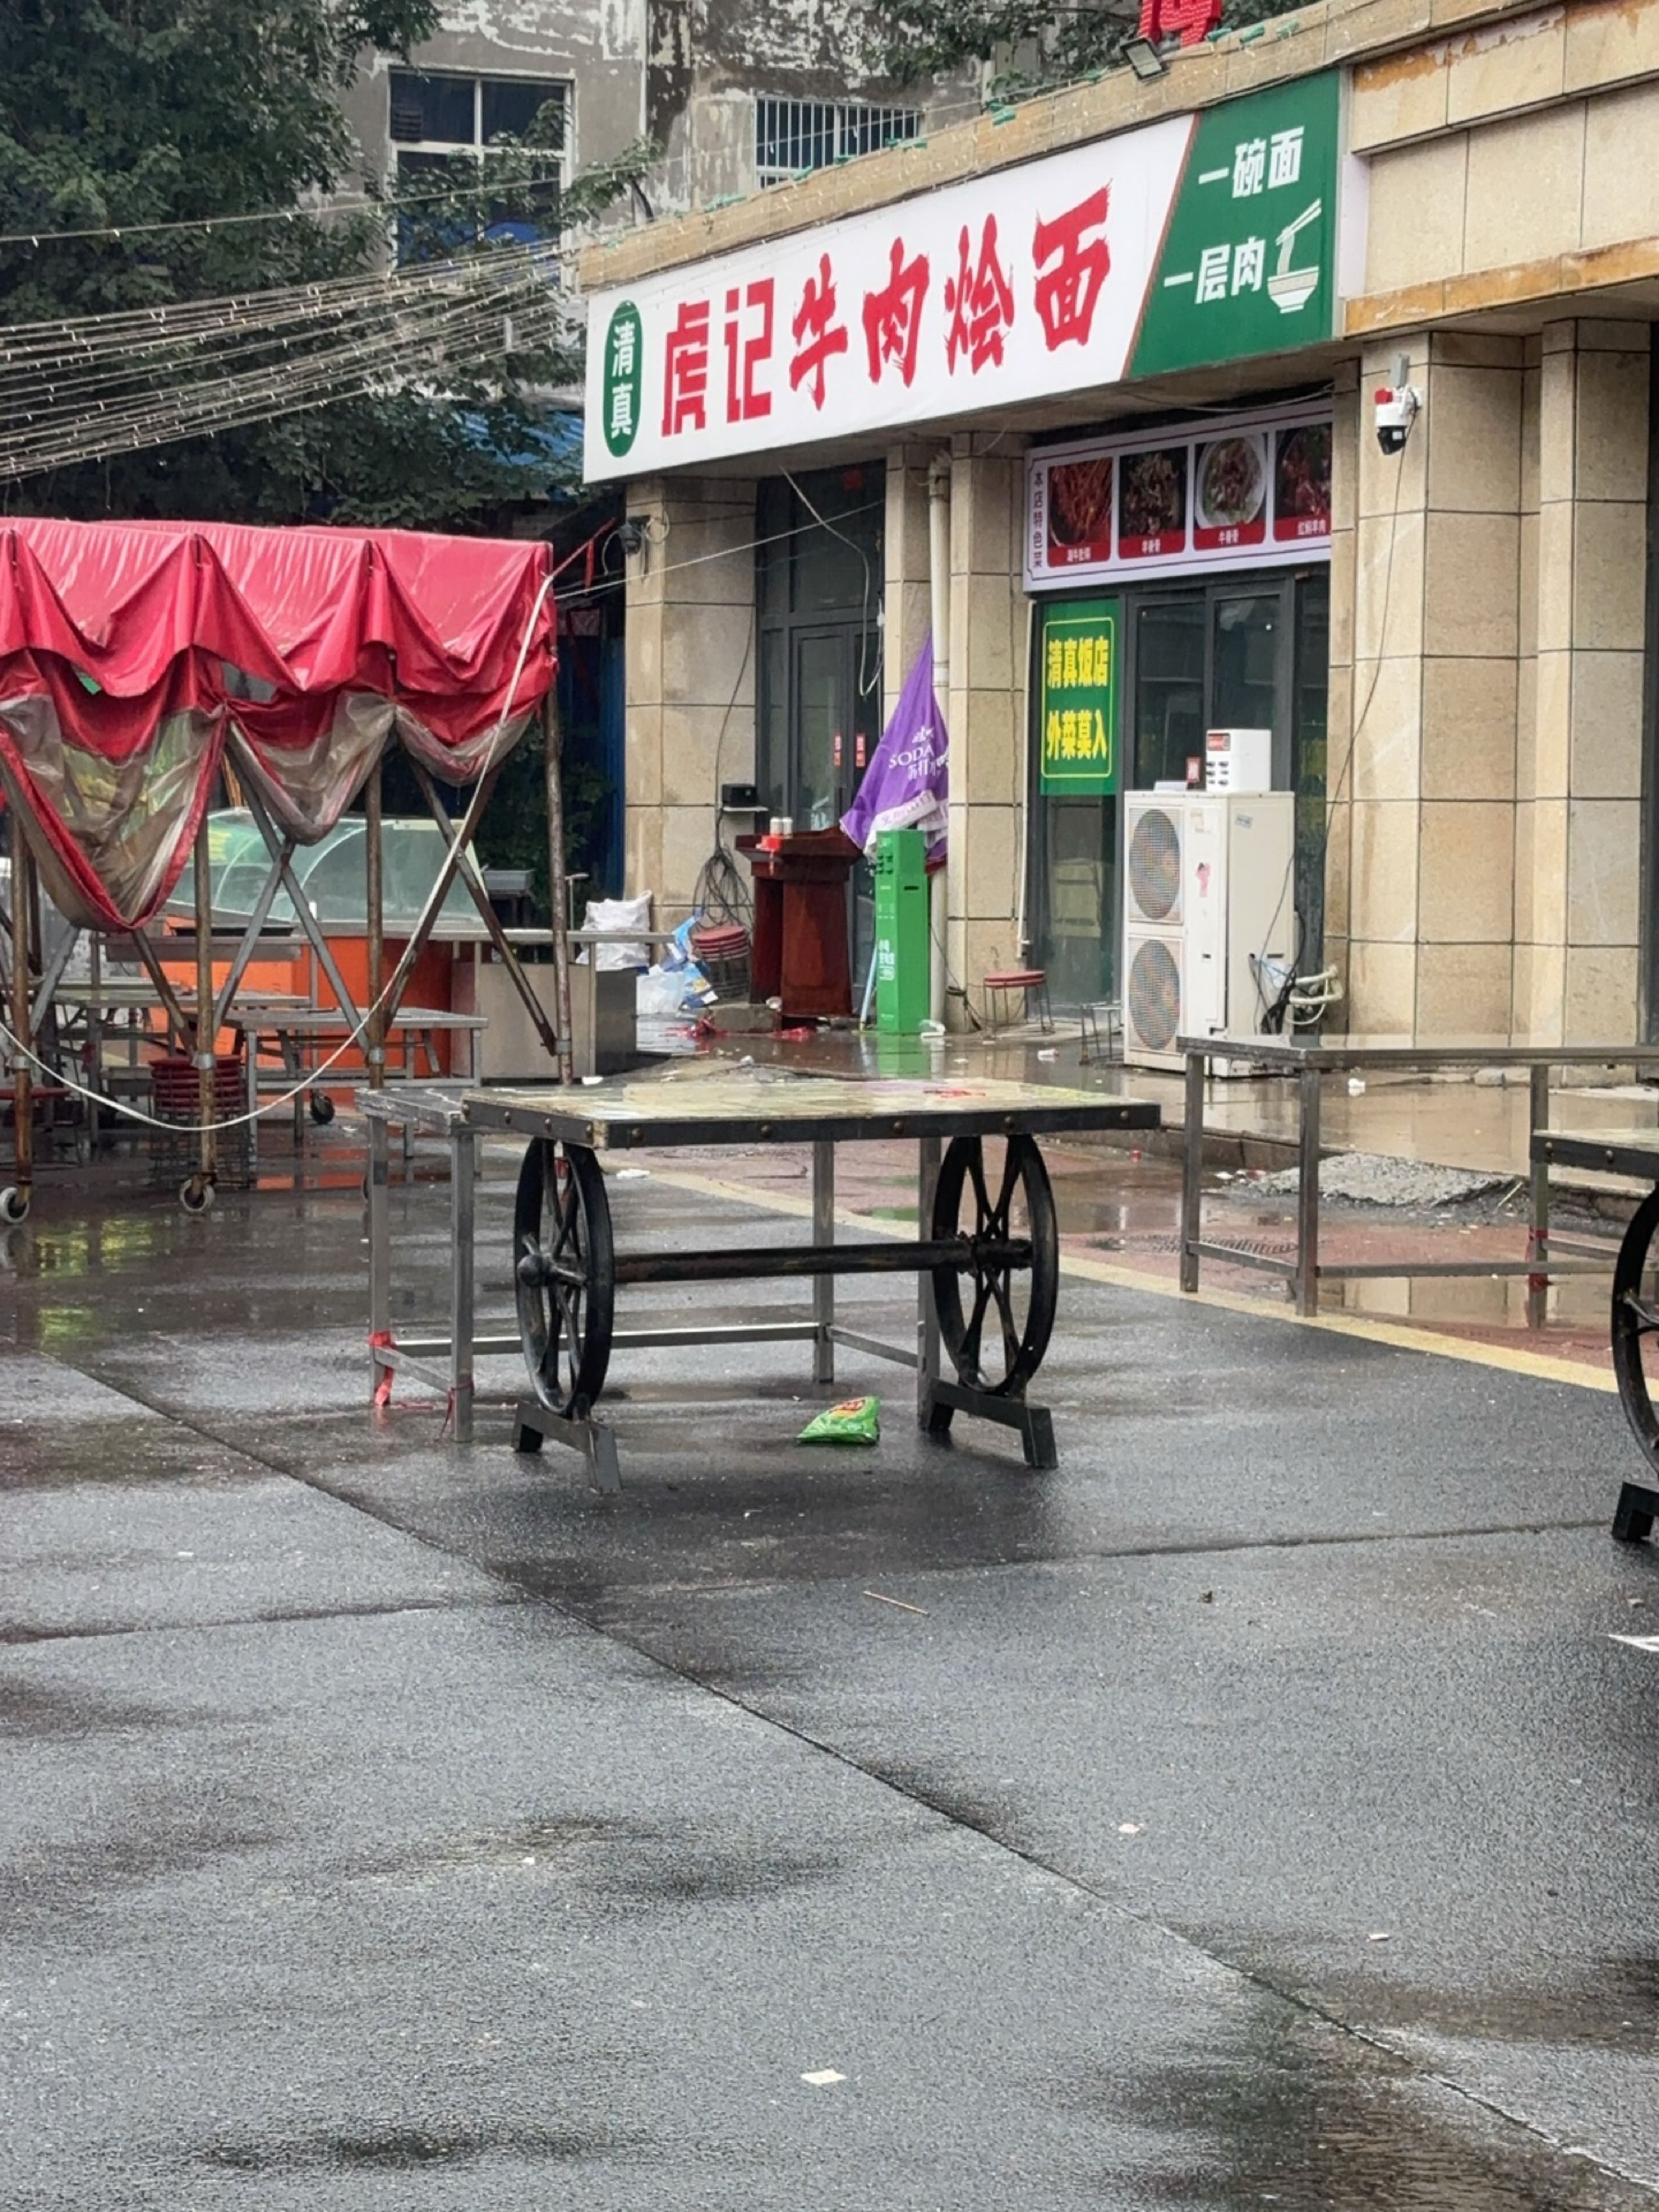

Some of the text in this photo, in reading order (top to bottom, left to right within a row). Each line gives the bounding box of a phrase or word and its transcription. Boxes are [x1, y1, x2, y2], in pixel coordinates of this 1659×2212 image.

[1199, 127, 1304, 198] 一碗面
[1164, 236, 1265, 304] 一层肉
[661, 179, 1112, 438] 虎记牛肉烩面
[611, 321, 636, 438] 清真
[888, 743, 934, 769] SODA
[1046, 709, 1107, 760] 外菜莫入
